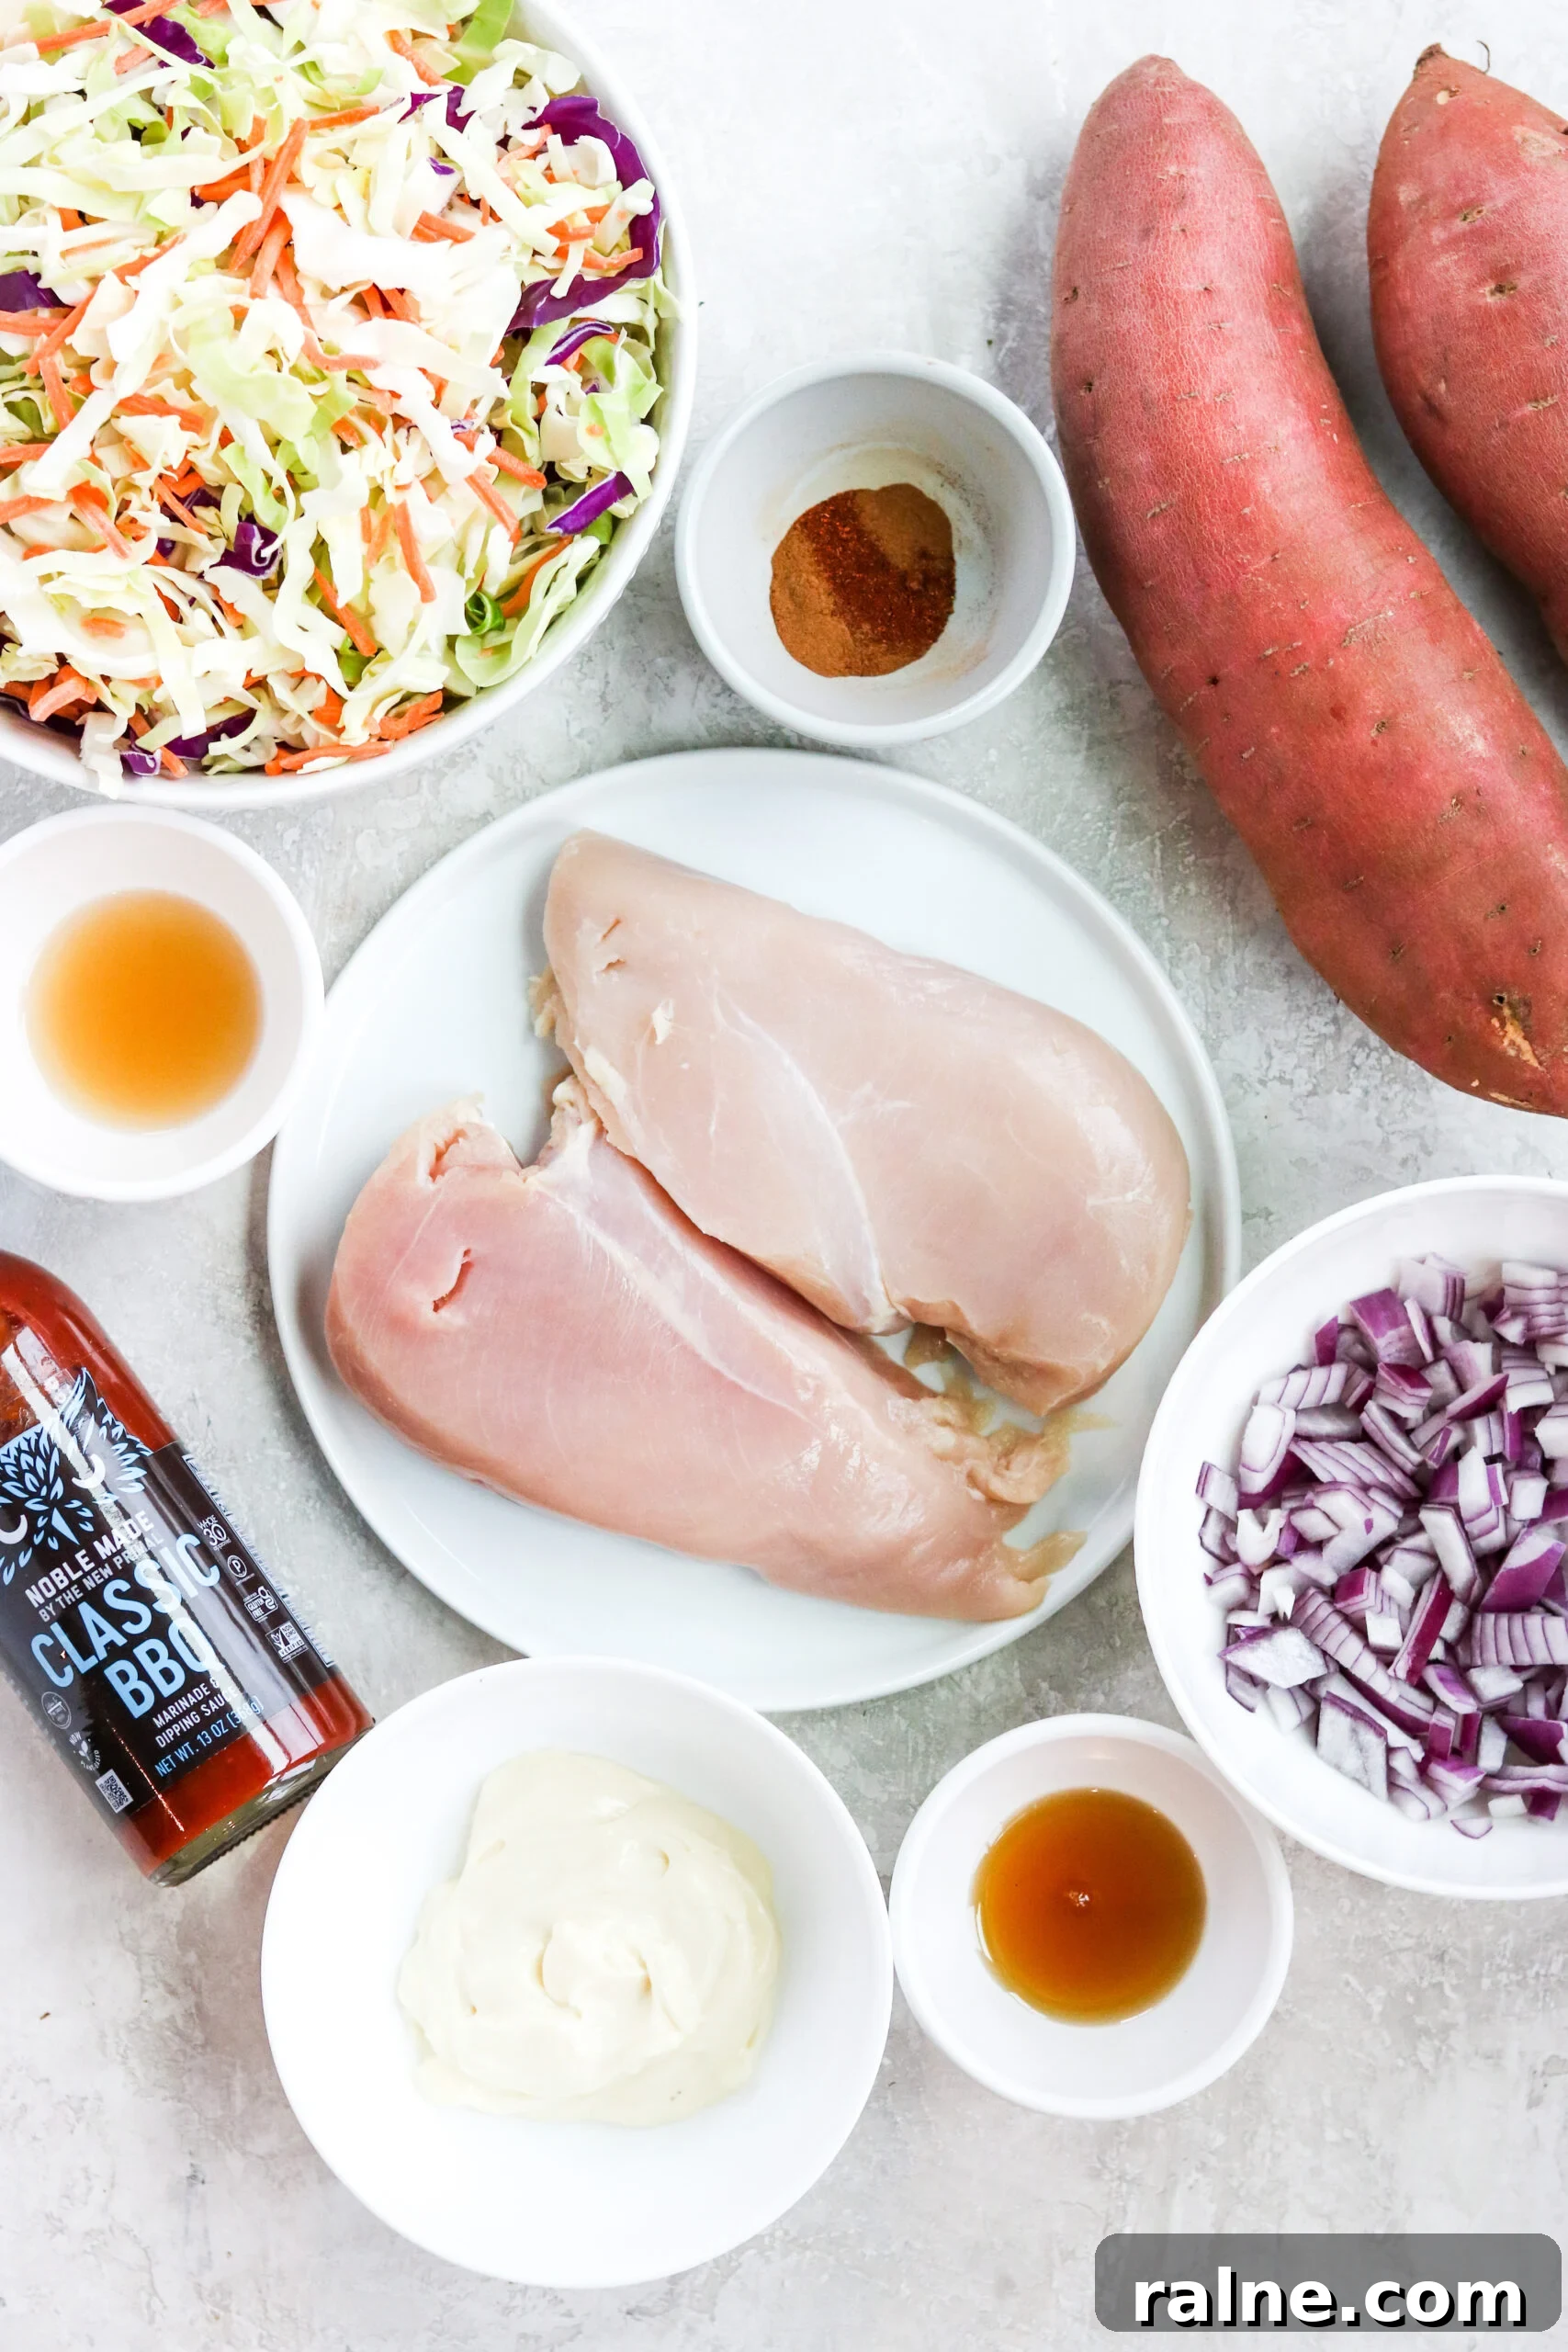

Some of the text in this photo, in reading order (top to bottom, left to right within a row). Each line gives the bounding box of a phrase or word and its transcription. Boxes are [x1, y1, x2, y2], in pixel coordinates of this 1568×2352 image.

[25, 1510, 154, 1608] NOBLE MADE
[203, 1523, 227, 1546] 30
[30, 1533, 220, 1688] CLASSIC
[39, 1532, 164, 1623] BY THE NEW PRIMAL
[104, 1617, 225, 1719] BBQ
[152, 1682, 210, 1728] MARINADE
[154, 1755, 176, 1777] NET
[174, 1742, 199, 1762] WT.
[197, 1730, 212, 1747] 13
[210, 1719, 229, 1737] OZ
[155, 1685, 239, 1747] DIPPING SAUCE
